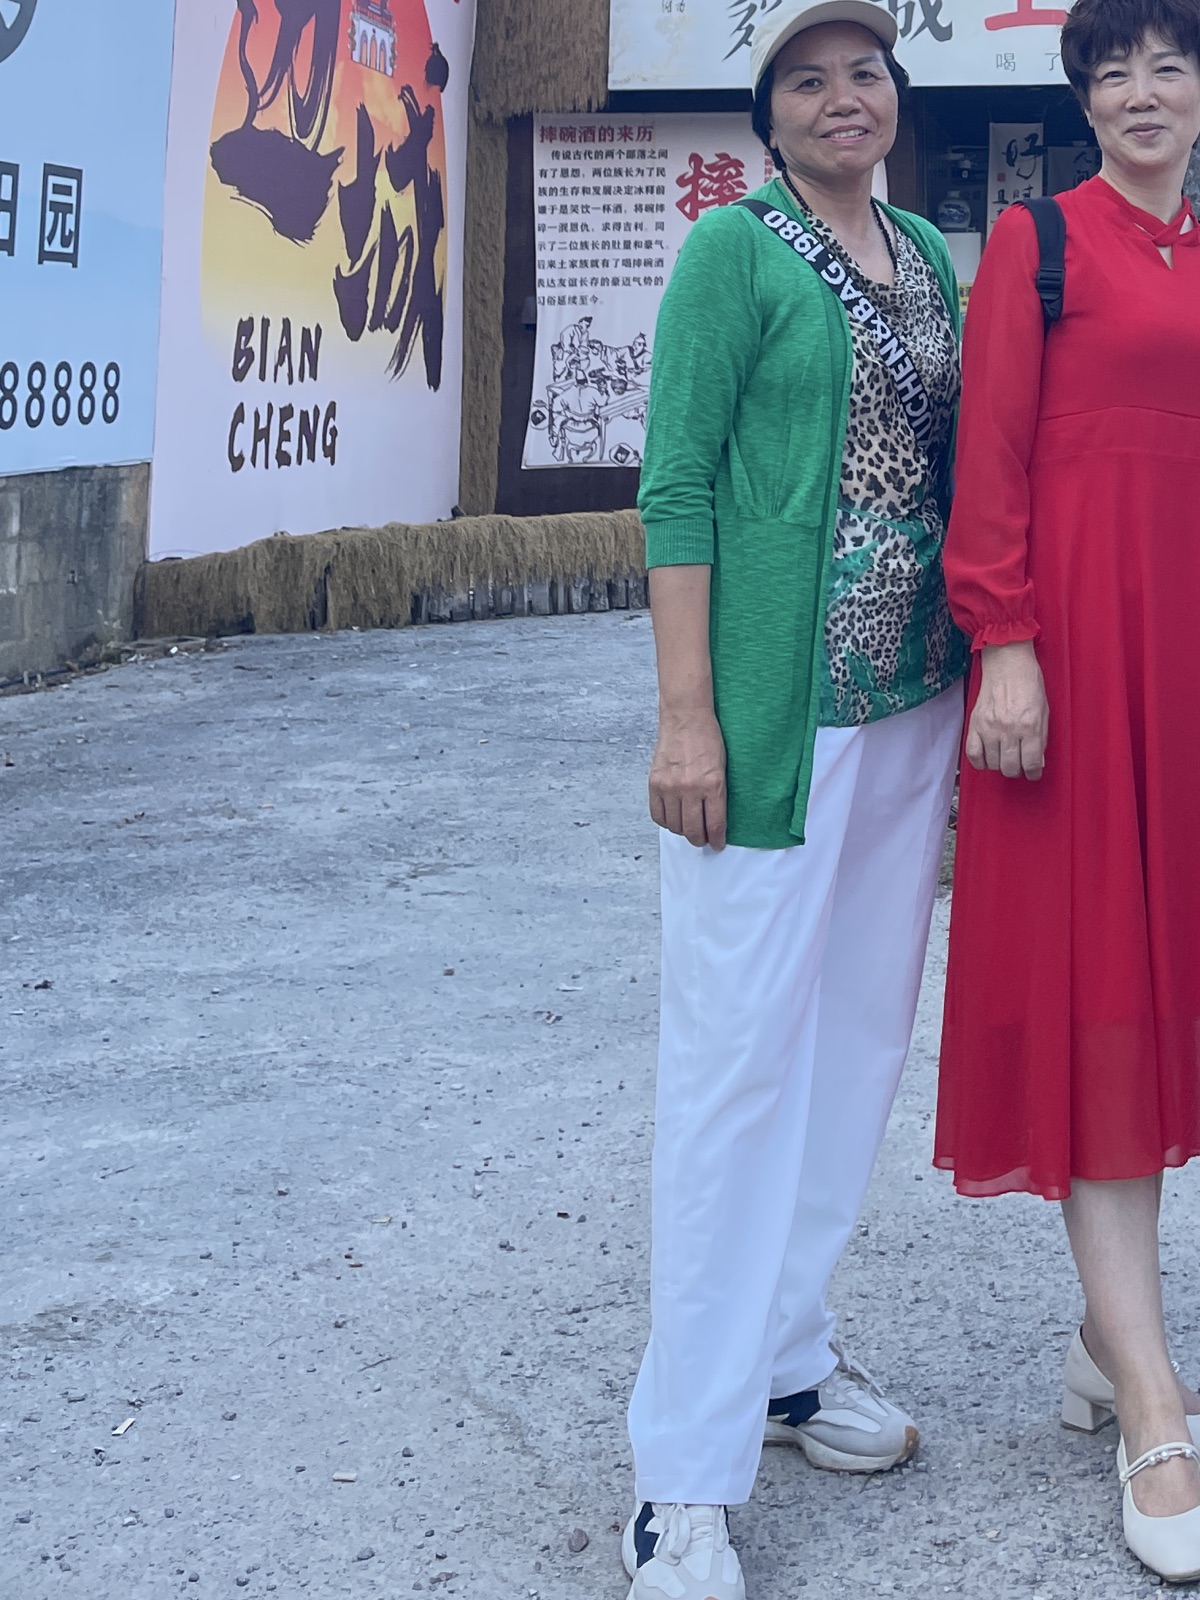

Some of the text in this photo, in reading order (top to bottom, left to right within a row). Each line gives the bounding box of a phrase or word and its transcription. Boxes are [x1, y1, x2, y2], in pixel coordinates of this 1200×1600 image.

[539, 125, 654, 144] 摔碗酒的来历
[231, 315, 323, 385] BIAN
[227, 400, 339, 473] CHENG
